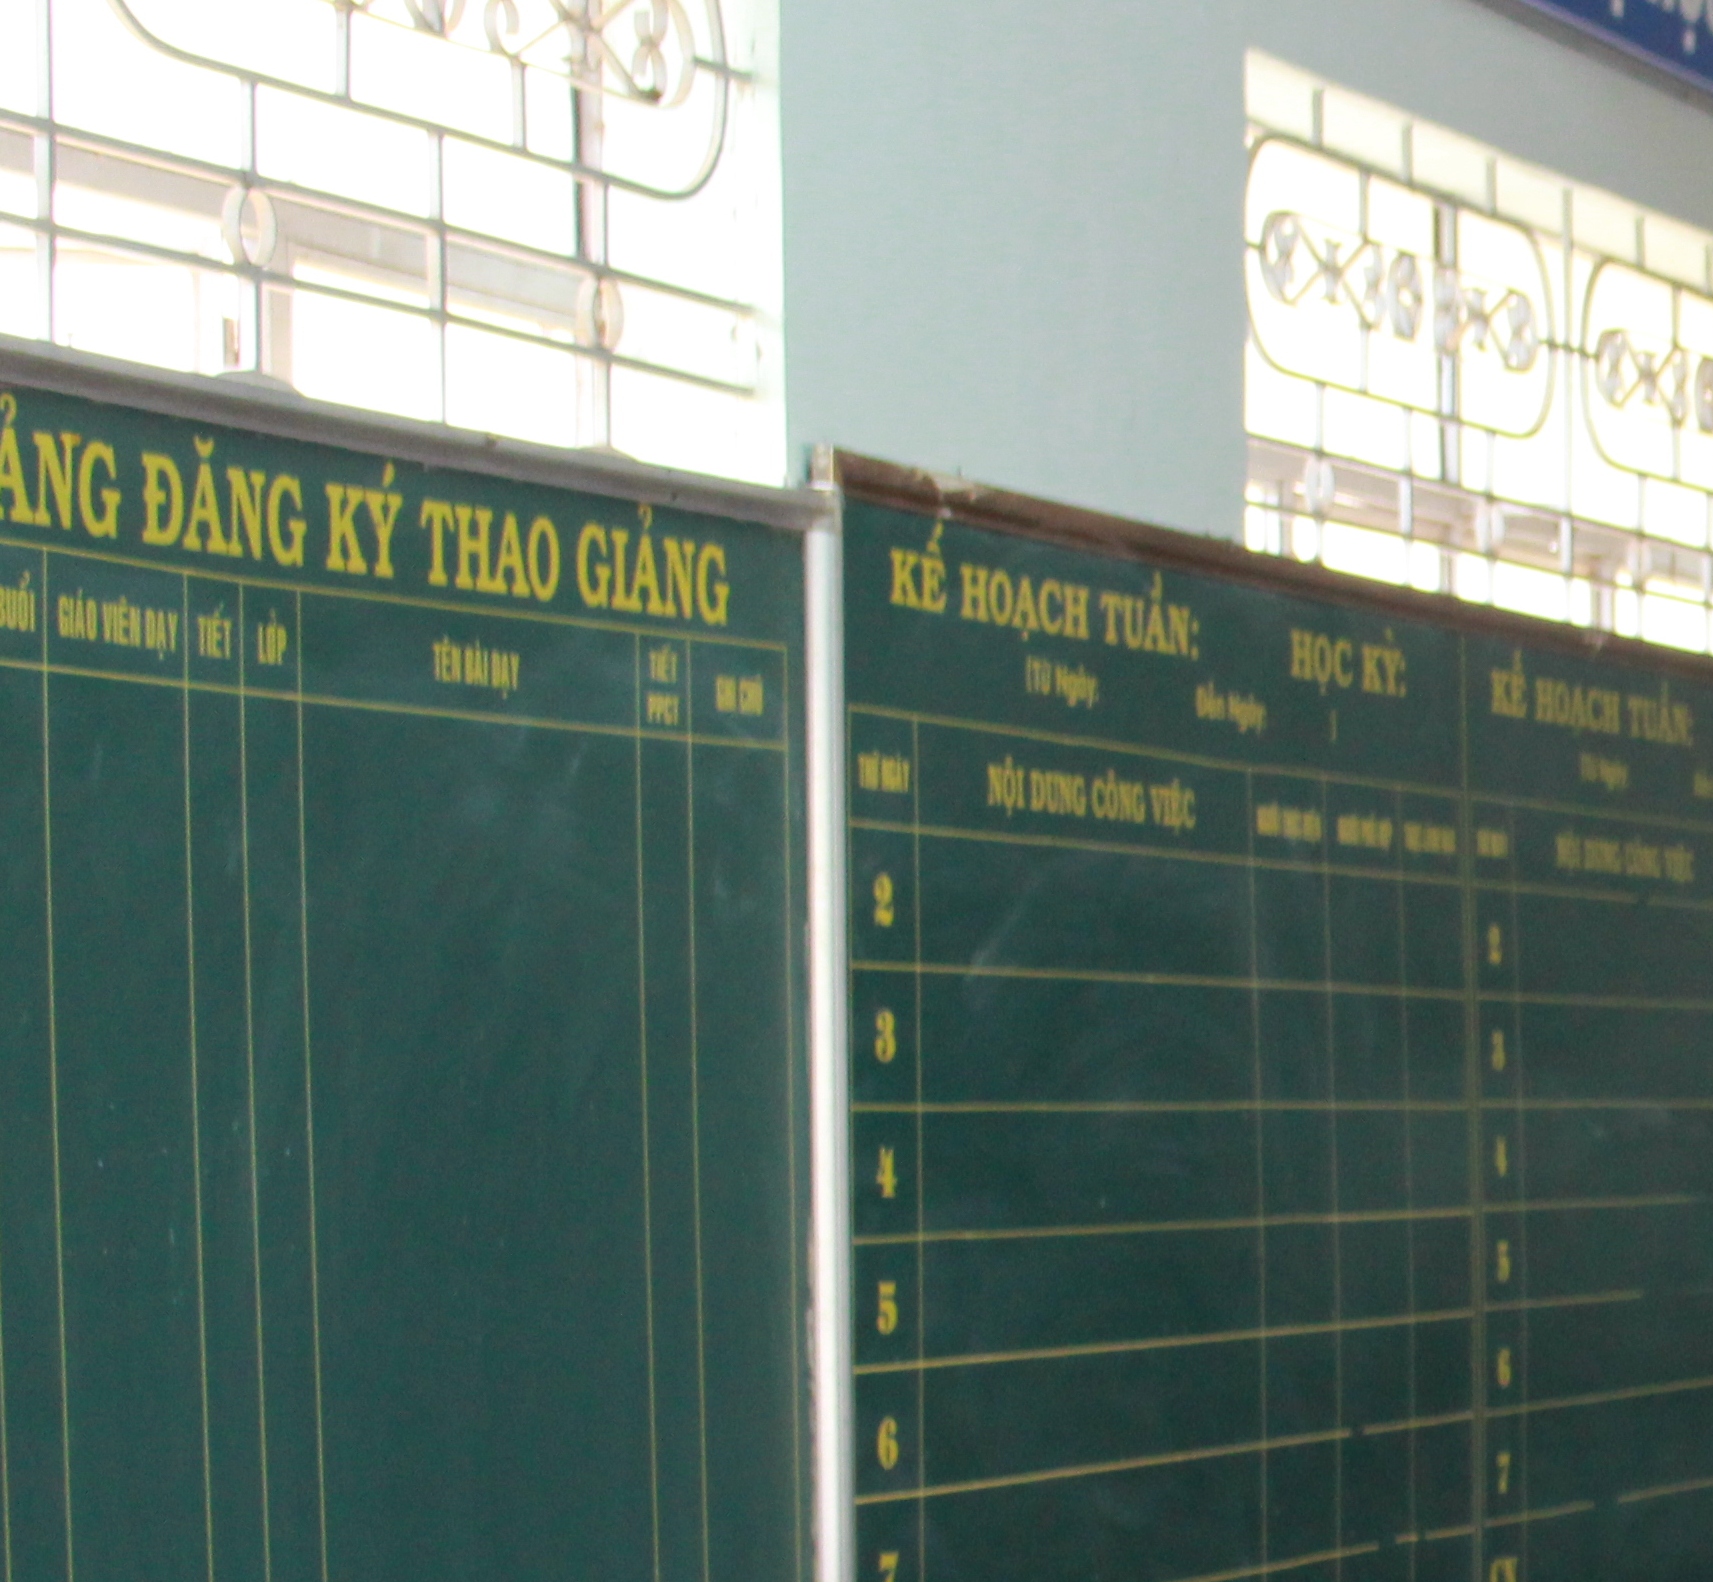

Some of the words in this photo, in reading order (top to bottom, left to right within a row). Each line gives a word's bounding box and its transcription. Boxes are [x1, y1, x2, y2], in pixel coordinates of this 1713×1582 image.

[0, 394, 121, 539] ẢNG
[142, 434, 307, 567] ĐĂNG
[324, 462, 403, 578] KÝ
[420, 498, 560, 601] THAO
[576, 502, 730, 626] GIẢNG
[58, 587, 97, 641] GIÁO
[102, 595, 140, 647] VIÊN
[145, 607, 178, 660] DẠY
[198, 602, 232, 659] TIẾT
[960, 562, 1090, 642] HOẠCH
[1290, 628, 1353, 696] HỌC
[987, 754, 1025, 817] NỘI
[1030, 770, 1086, 817] DUNG
[1092, 767, 1146, 824] CÔNG
[1150, 778, 1196, 835] VIỆC
[873, 872, 894, 927] 2
[875, 1008, 896, 1064] 3
[876, 1146, 897, 1199] 4
[877, 1281, 898, 1335] 5
[877, 1416, 899, 1470] 6
